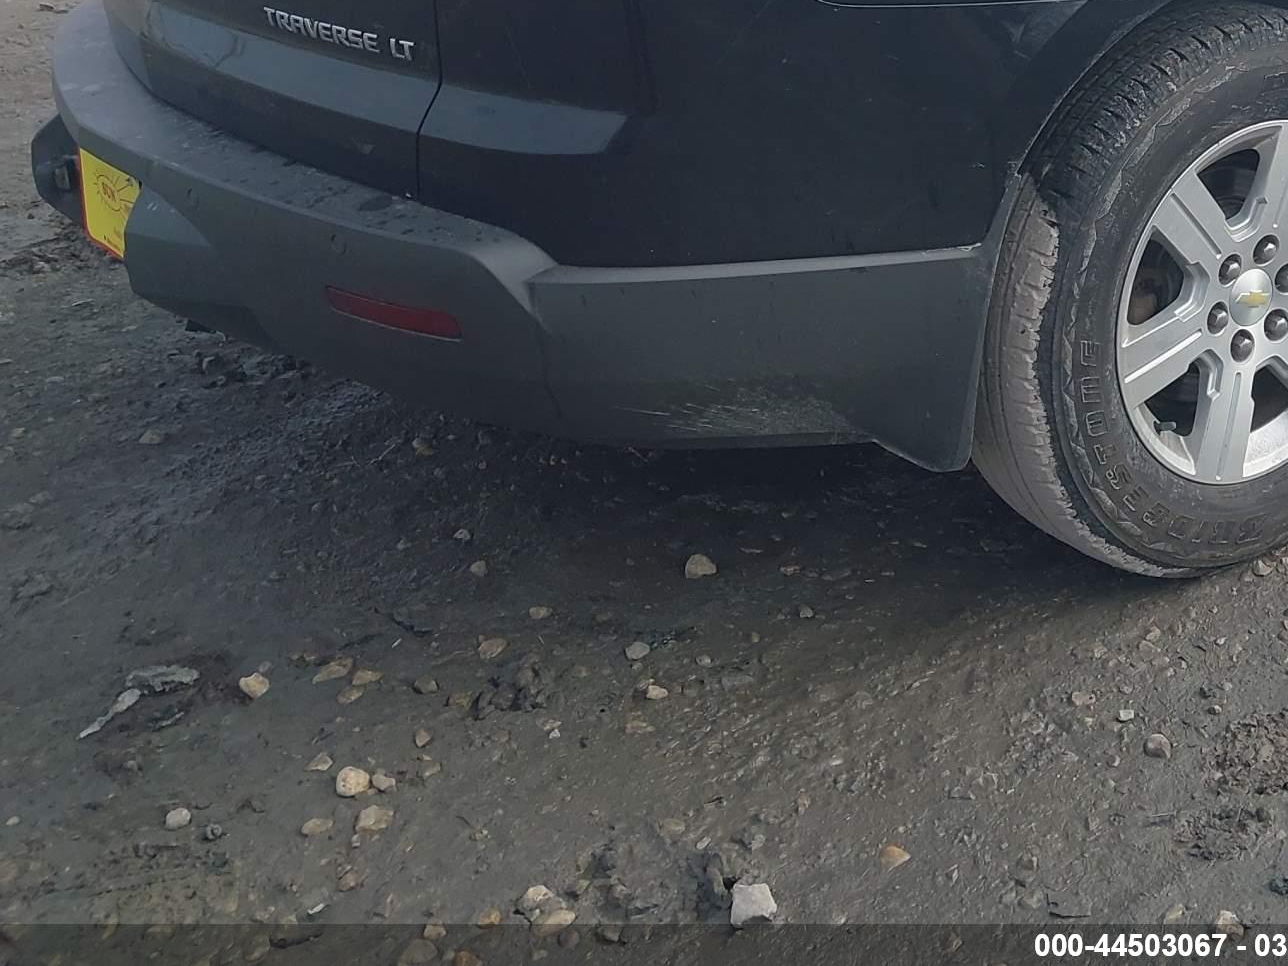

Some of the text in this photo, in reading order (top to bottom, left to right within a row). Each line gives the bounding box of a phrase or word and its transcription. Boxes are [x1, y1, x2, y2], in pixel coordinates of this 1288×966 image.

[263, 6, 414, 61] TRAVERSE LT
[1079, 339, 1266, 545] BRIDGESTONE
